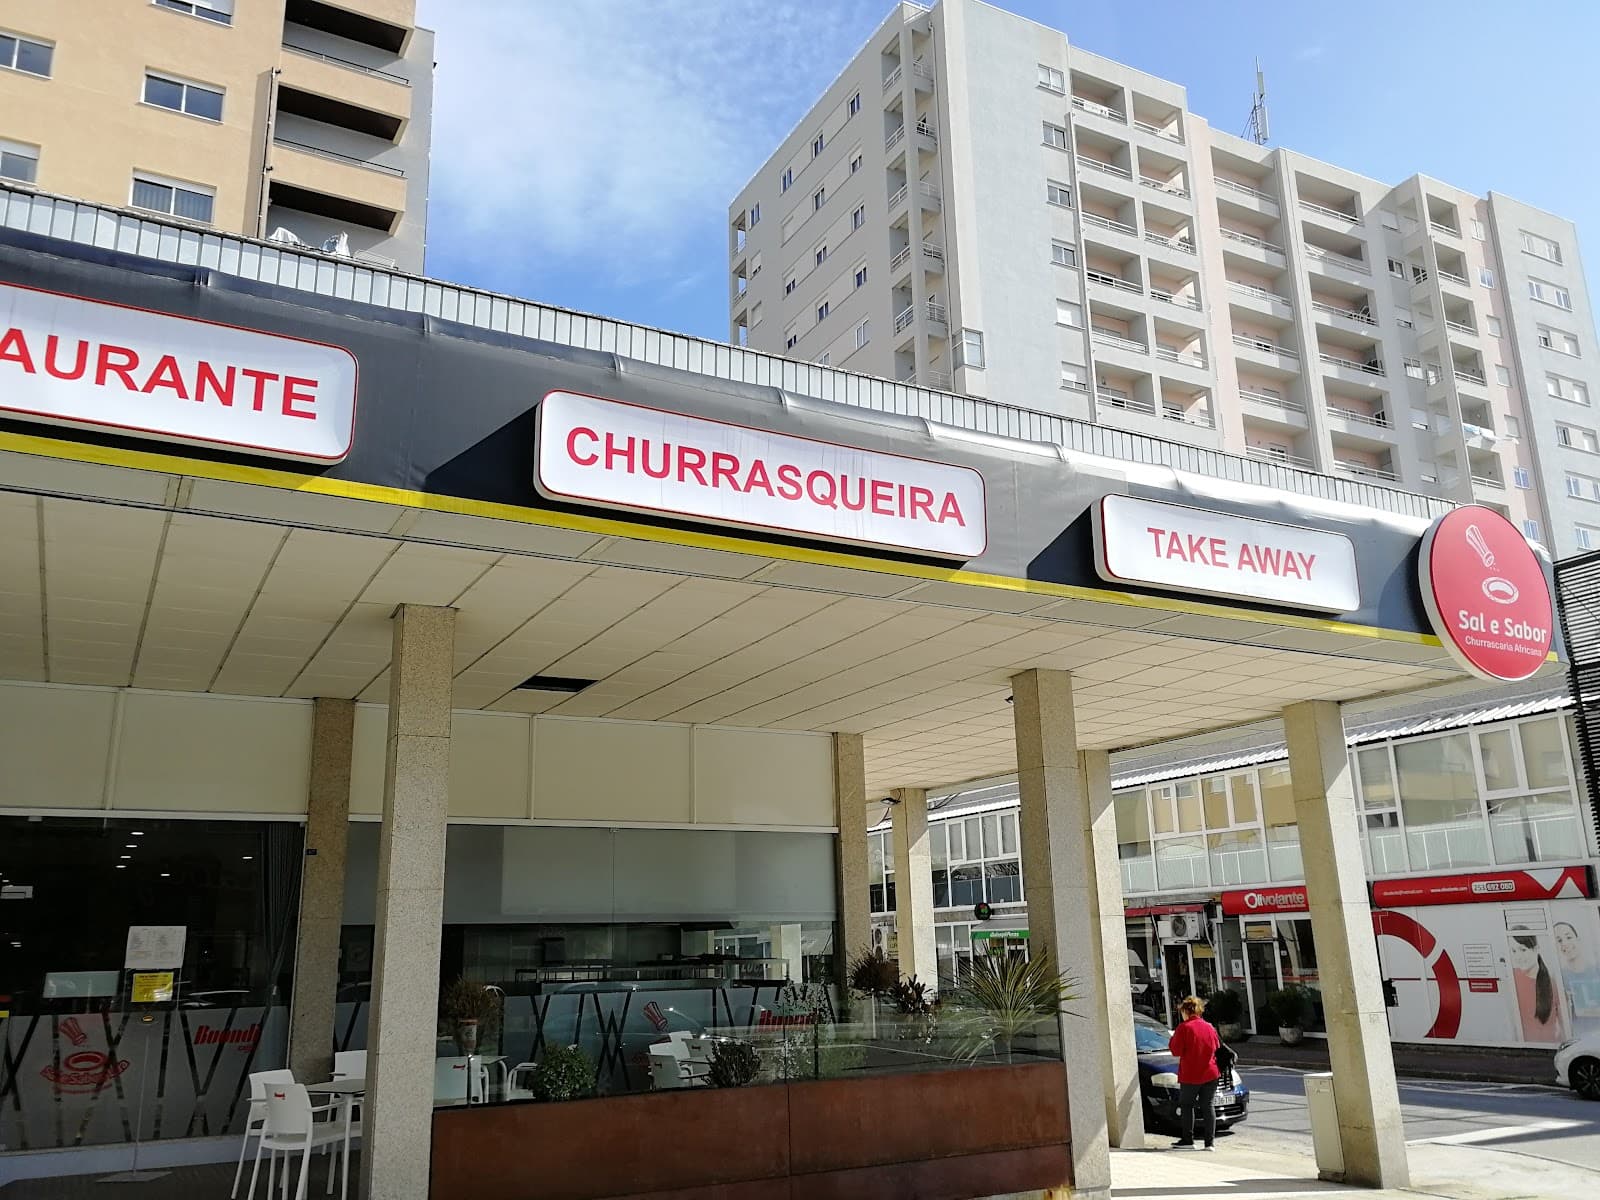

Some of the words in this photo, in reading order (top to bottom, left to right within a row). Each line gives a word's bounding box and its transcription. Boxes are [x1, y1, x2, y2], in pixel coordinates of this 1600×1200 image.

[566, 426, 966, 527] CHURRASQUEIRA
[1147, 527, 1229, 568] TAKE
[1238, 543, 1317, 581] AWAY
[1458, 609, 1486, 633] Sal
[1490, 619, 1499, 634] e
[1504, 617, 1547, 644] Sabor
[1465, 635, 1514, 652] Churrascaria
[1244, 891, 1305, 909] Olivolante
